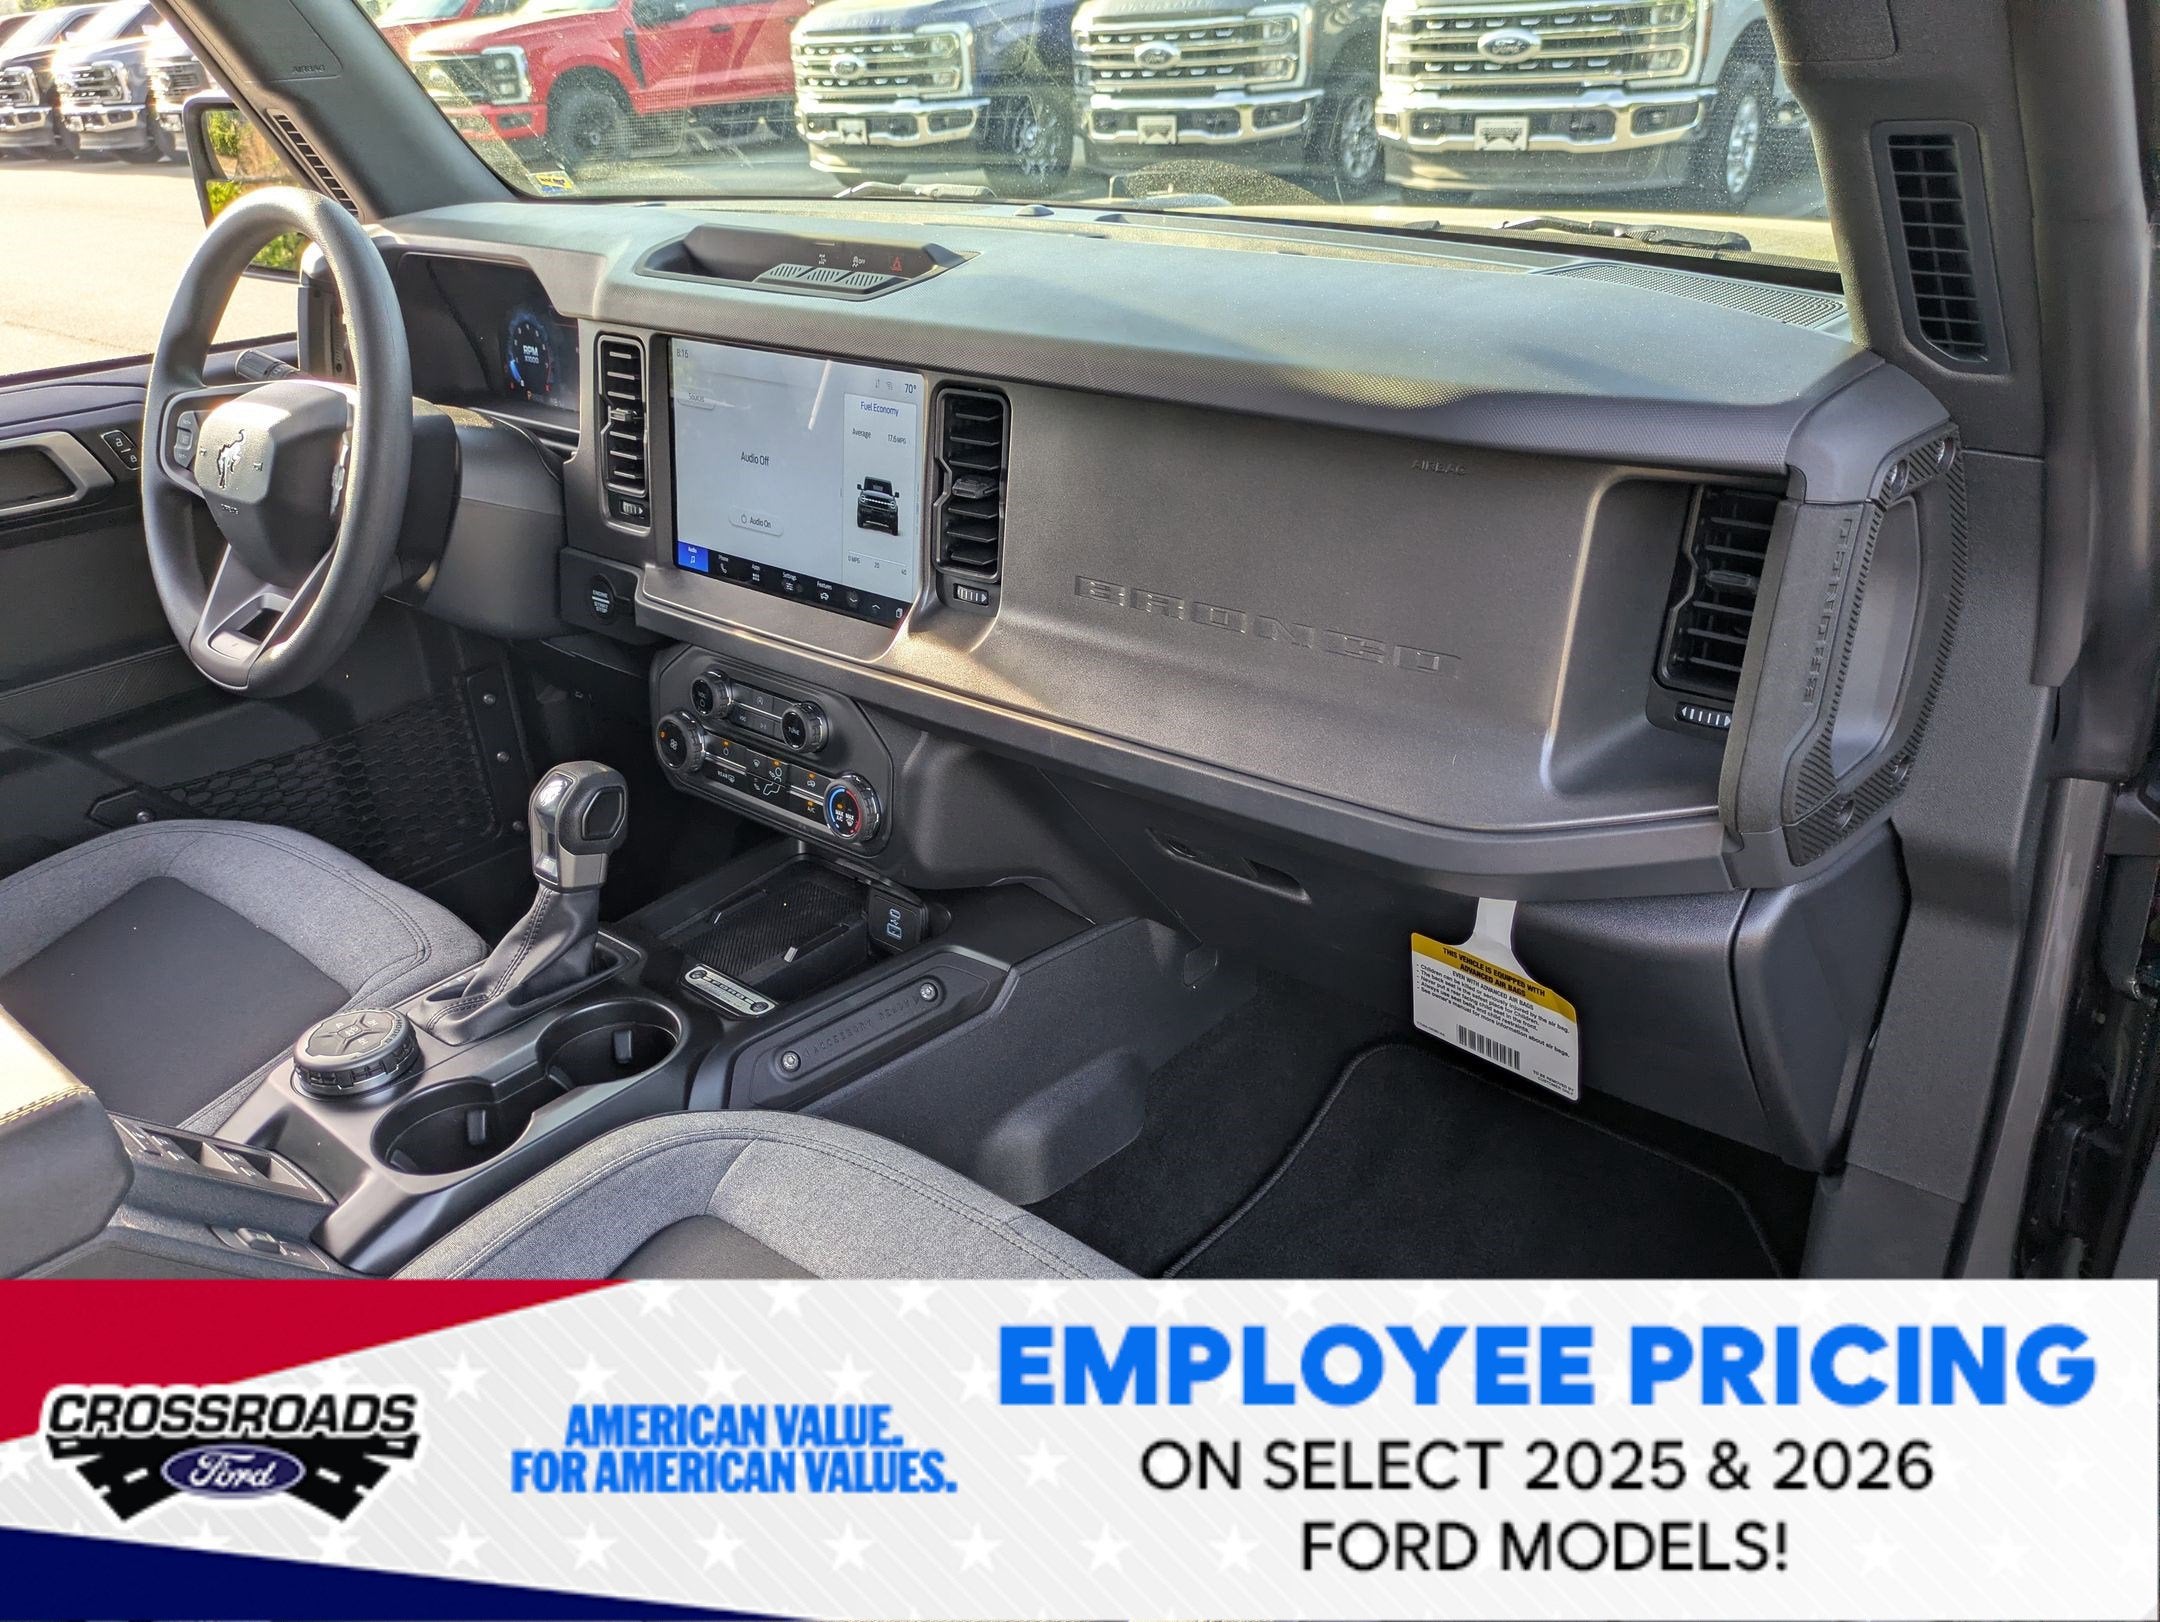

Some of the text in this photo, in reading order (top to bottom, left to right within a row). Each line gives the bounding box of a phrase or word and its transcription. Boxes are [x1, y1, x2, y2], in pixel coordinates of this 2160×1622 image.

[523, 345, 539, 356] RPM
[861, 401, 899, 417] Fuel Economy
[904, 383, 917, 394] 70°
[852, 428, 871, 439] Average
[741, 452, 769, 466] Audio Off
[750, 516, 772, 529] Audio On
[1075, 574, 1462, 680] BRONCO
[1443, 947, 1545, 998] THIS VEHICLE IS EQUIPPED WITH
[1452, 970, 1534, 1011] EVEN WITH ADVANCED AIR BAGS
[1460, 963, 1526, 998] ADVANCED AIR BAGS
[1421, 970, 1430, 978] The
[1432, 975, 1444, 984] back
[1445, 981, 1456, 989] seat
[1462, 988, 1471, 996] the
[1472, 992, 1488, 1003] safest
[1489, 1000, 1503, 1011] place
[1514, 1011, 1539, 1026] Children.
[1421, 965, 1442, 978] Children
[1444, 974, 1453, 982] can
[1462, 982, 1475, 992] killed
[1484, 992, 1508, 1007] seriously
[1509, 1003, 1529, 1016] injured
[1530, 1012, 1537, 1020] by
[1538, 1016, 1547, 1024] the
[1548, 1020, 1556, 1028] air
[1557, 1024, 1570, 1035] bag.
[1421, 976, 1436, 986] Never
[1436, 983, 1446, 991] put
[1451, 989, 1461, 997] rear
[1462, 994, 1478, 1006] facing
[1479, 1001, 1492, 1011] child
[1494, 1008, 1505, 1016] seat
[1522, 1020, 1538, 1031] front.
[1422, 982, 1530, 1033] Always use seat belts and child restraints.
[1421, 987, 1570, 1058] See owner's manual for more information about air bags.
